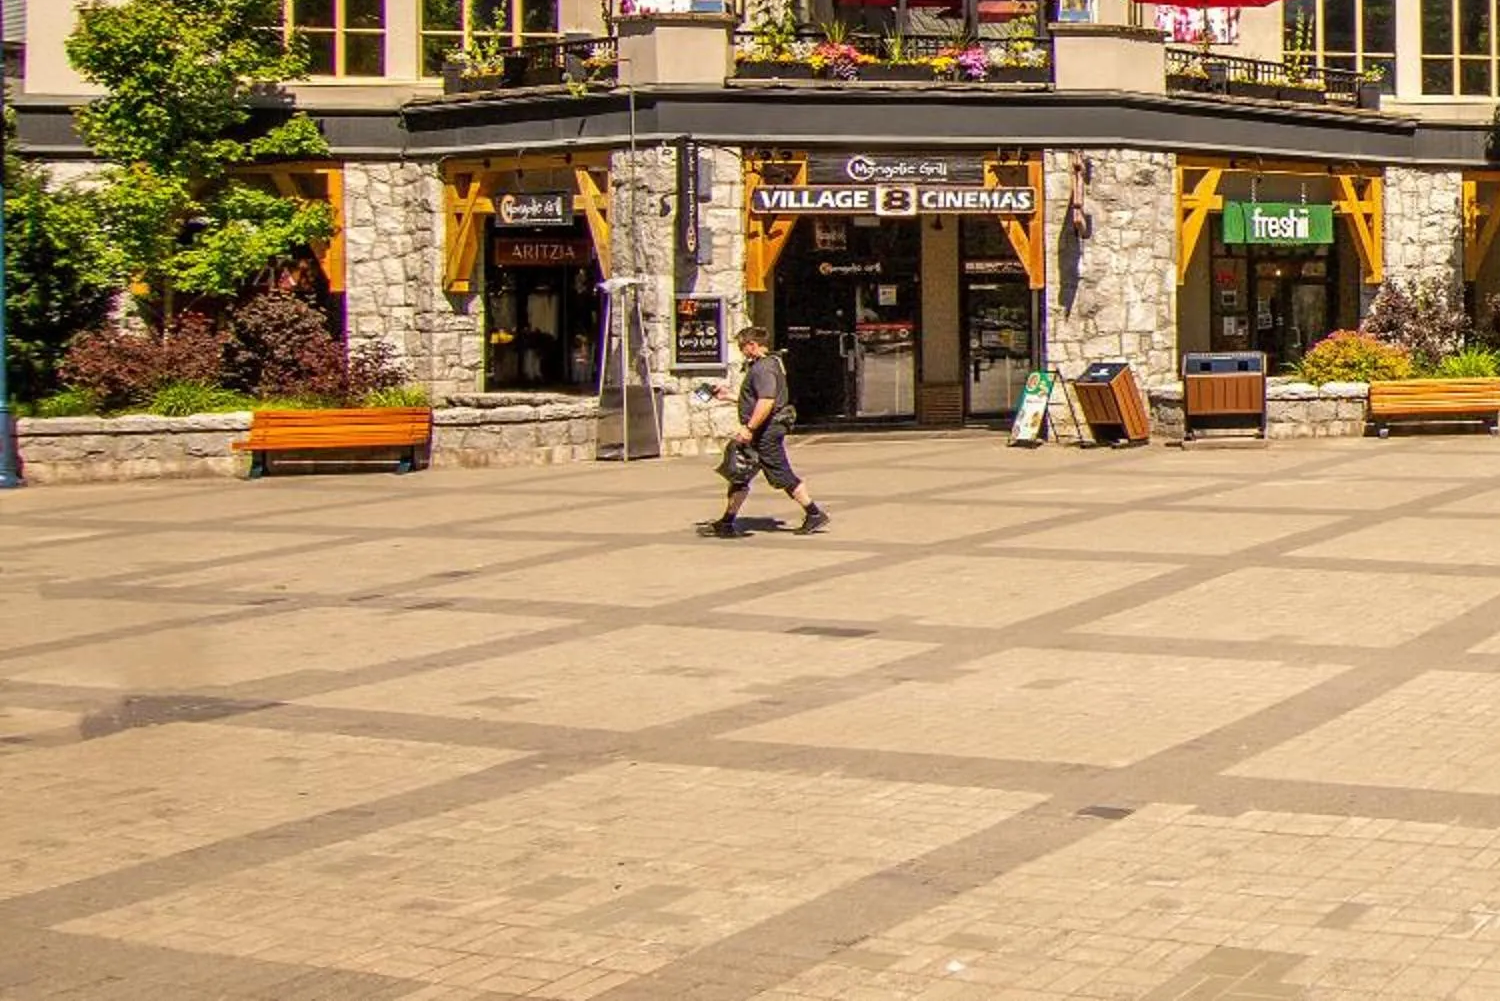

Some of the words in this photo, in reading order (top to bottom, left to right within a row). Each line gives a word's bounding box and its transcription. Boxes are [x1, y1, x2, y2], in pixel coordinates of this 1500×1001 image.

[919, 160, 947, 176] Grill
[760, 190, 869, 208] VILLAGE
[882, 189, 911, 212] 8
[921, 191, 1031, 210] CINEMAS
[1253, 207, 1309, 238] freshii
[511, 243, 576, 260] ARITZIA
